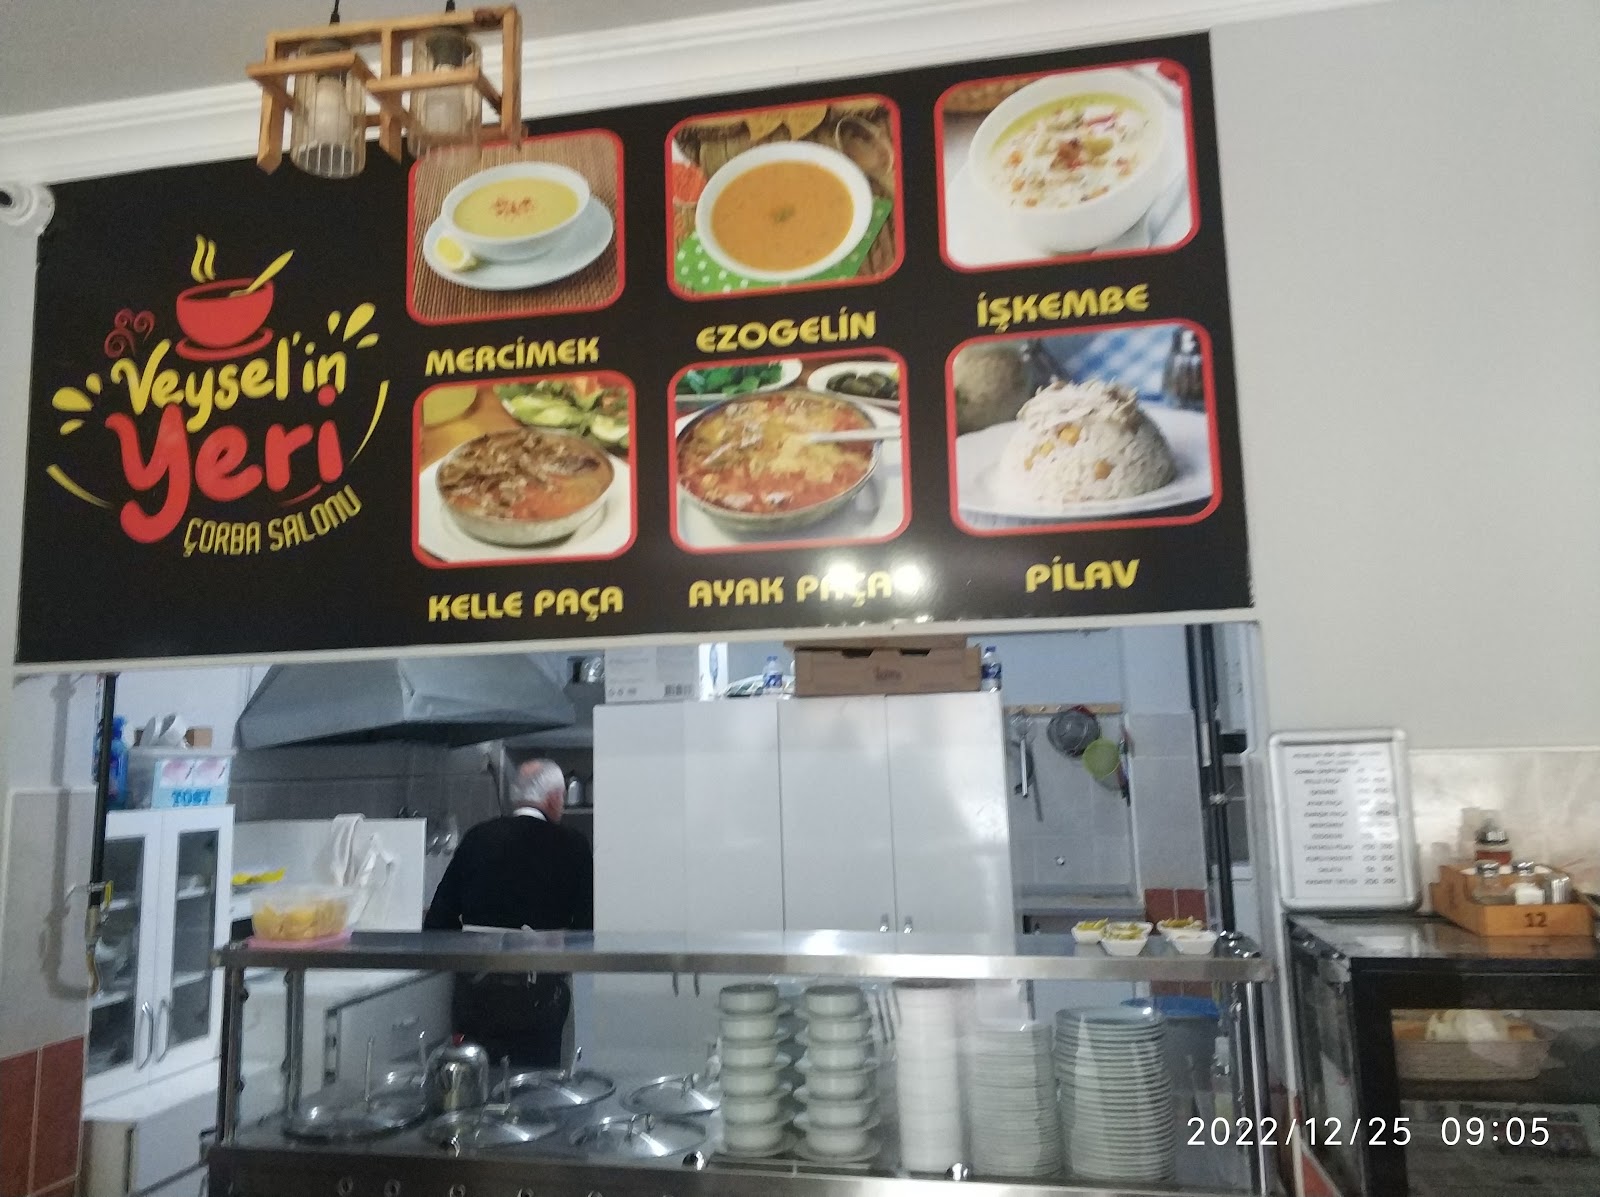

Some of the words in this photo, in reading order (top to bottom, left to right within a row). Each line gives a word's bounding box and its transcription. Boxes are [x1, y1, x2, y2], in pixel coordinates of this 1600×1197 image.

[977, 284, 1149, 333] İŞKEMBE
[696, 306, 877, 353] EZOGELİN
[425, 335, 599, 376] MERCİMEK
[183, 517, 262, 558] ÇORBA
[689, 576, 784, 608] AYAK
[1025, 555, 1140, 594] PİLAV
[428, 592, 522, 623] KELLE
[534, 586, 624, 623] PAÇA
[1525, 911, 1548, 928] 12
